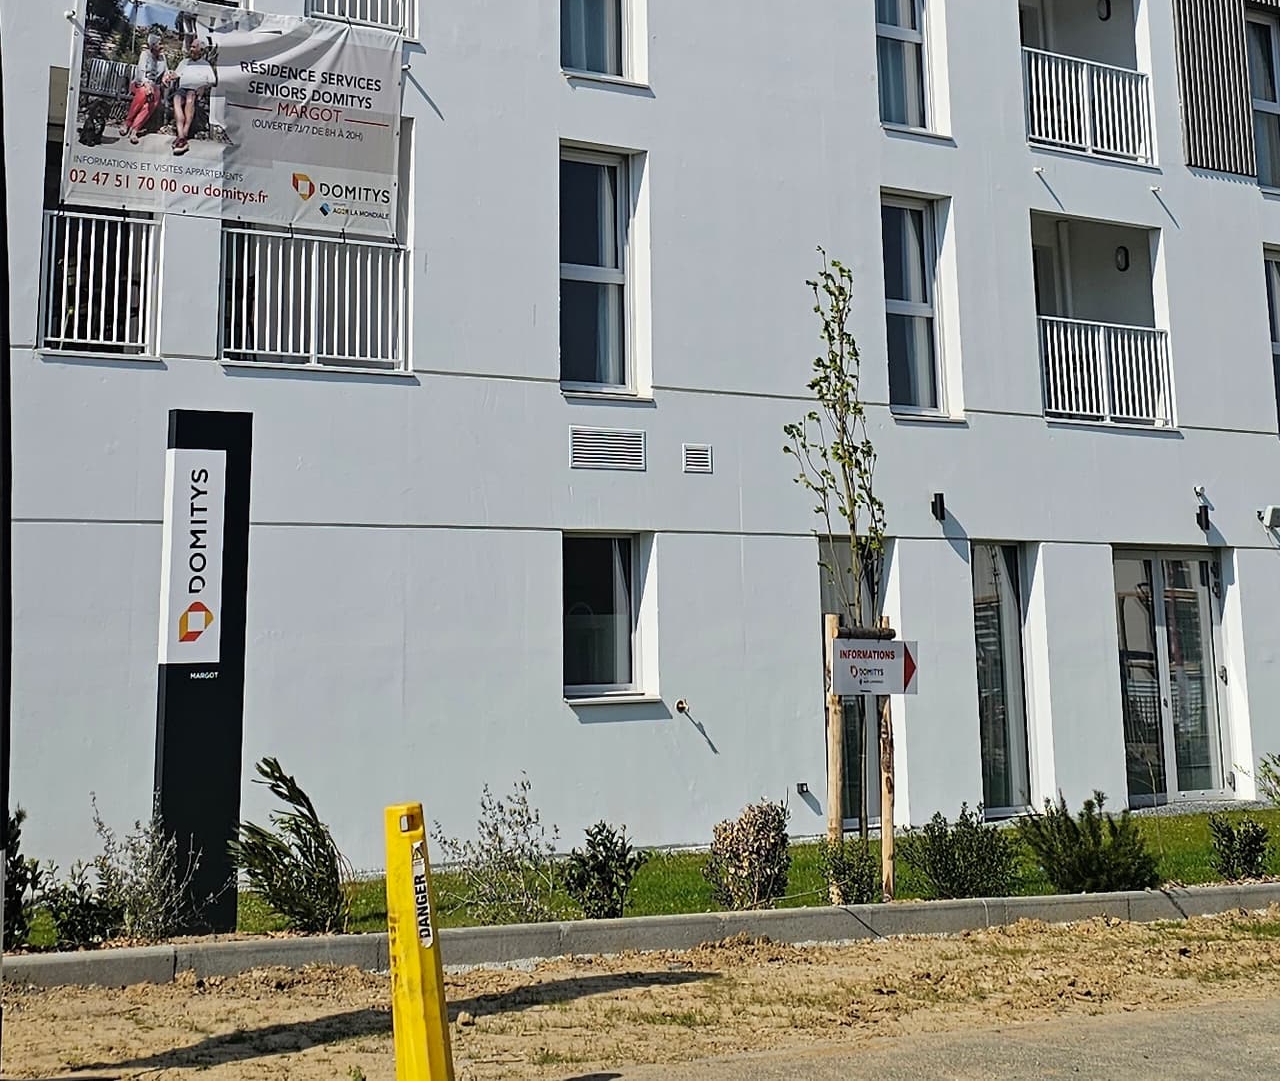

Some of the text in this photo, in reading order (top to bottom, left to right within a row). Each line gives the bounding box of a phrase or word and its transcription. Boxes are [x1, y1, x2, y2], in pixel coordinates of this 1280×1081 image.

[240, 60, 382, 92] RÉSIDENCE SERVICES
[248, 80, 372, 109] SENIORS DOMITYS
[277, 102, 343, 123] MARGOT
[252, 119, 293, 132] (OUVERTE
[311, 126, 324, 136] DE
[324, 127, 336, 137] 8H
[337, 127, 345, 138] À
[73, 155, 244, 182] INFORMATIONS ET VISITES APPARTEMENTS
[70, 168, 268, 205] 02 47 51 70 00 ou domitys.fr
[320, 182, 390, 204] DOMITYS
[188, 468, 209, 594] DOMITYS
[839, 649, 895, 660] INFORMATIONS
[190, 671, 219, 680] MARGOT
[414, 874, 431, 938] DANGER
